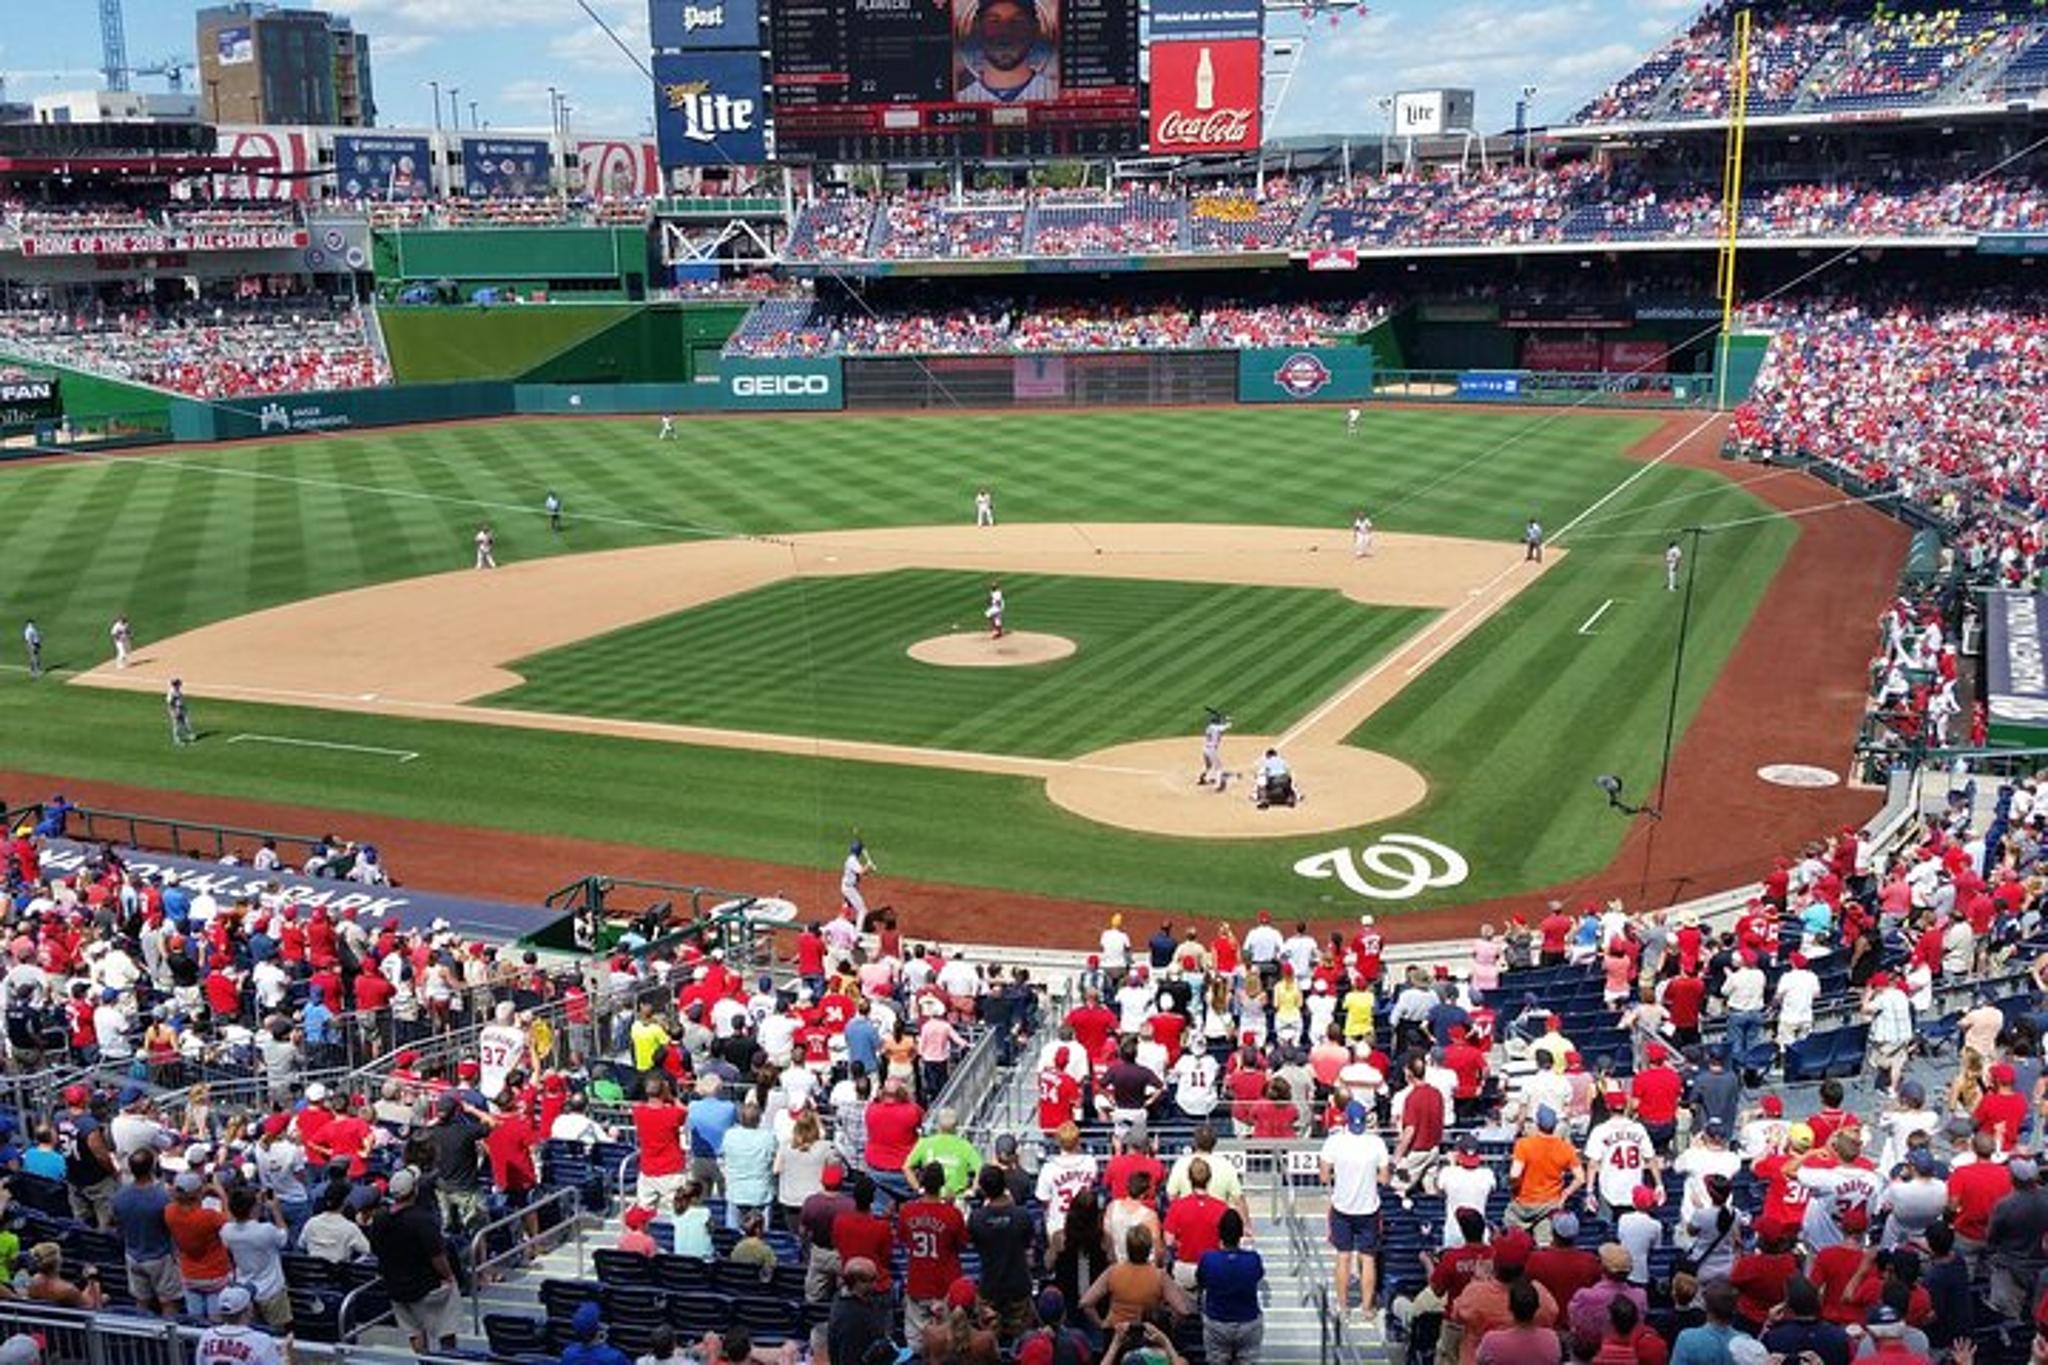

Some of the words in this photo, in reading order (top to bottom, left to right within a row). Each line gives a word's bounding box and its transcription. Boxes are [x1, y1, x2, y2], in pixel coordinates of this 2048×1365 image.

[683, 5, 724, 32] Post
[684, 93, 753, 143] Lite
[1406, 104, 1435, 126] Lite
[732, 375, 829, 396] GEICO
[482, 1046, 507, 1067] 37
[1610, 1145, 1640, 1169] 48
[912, 1231, 939, 1258] 31
